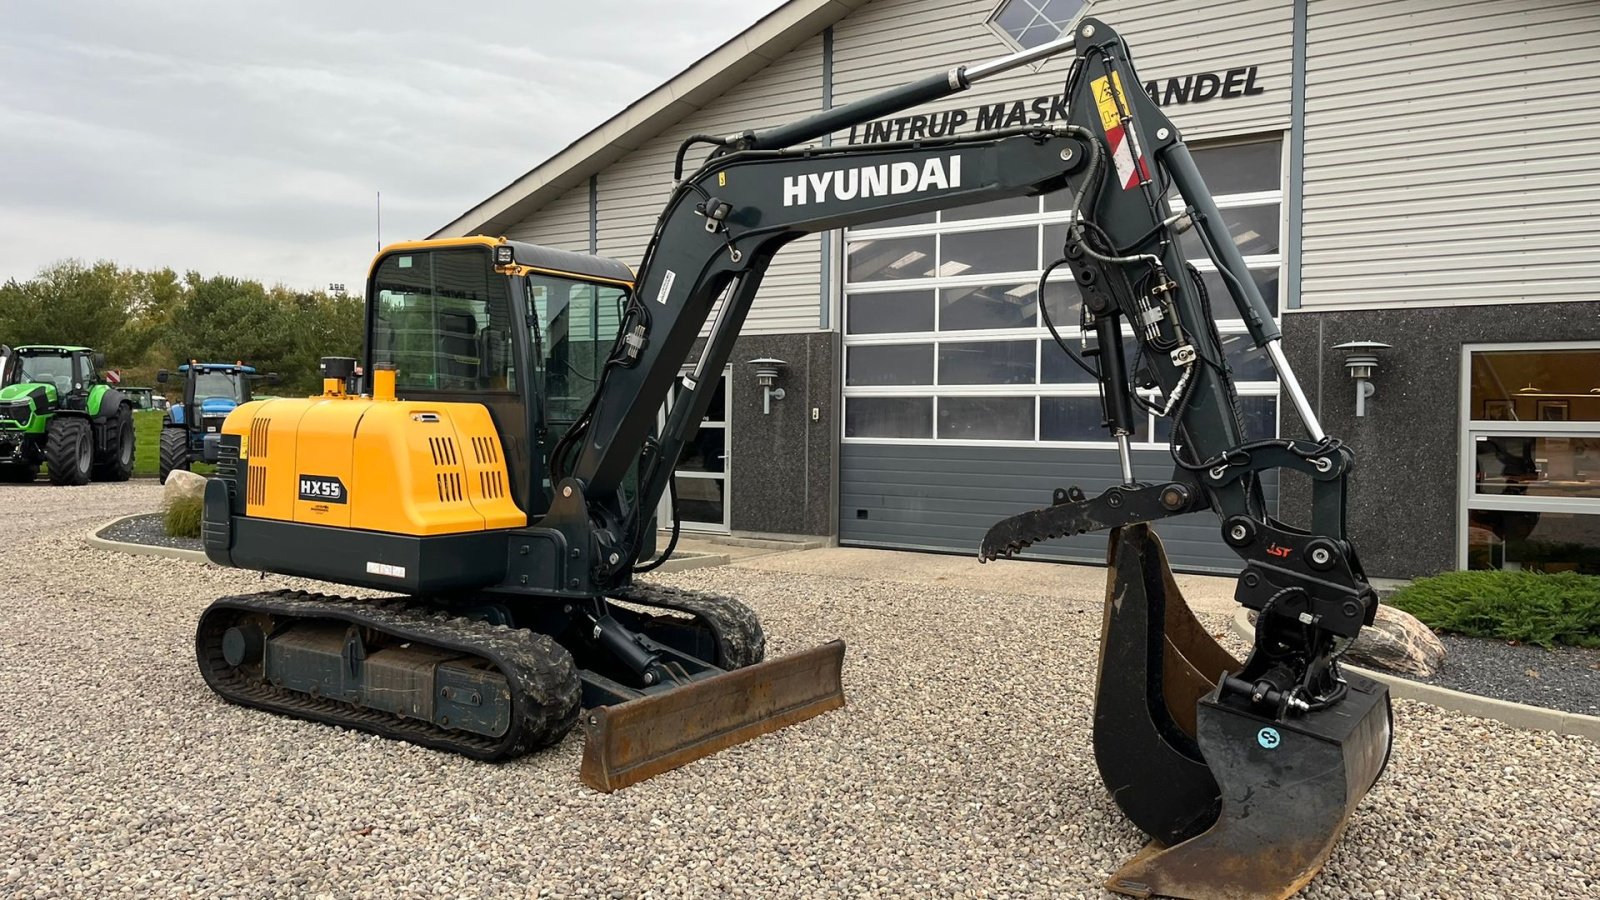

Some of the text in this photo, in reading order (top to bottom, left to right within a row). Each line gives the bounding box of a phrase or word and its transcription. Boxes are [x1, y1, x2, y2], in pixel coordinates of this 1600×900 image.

[848, 110, 968, 145] LINTRUP
[783, 155, 961, 207] HYUNDAI
[300, 480, 340, 497] HX55
